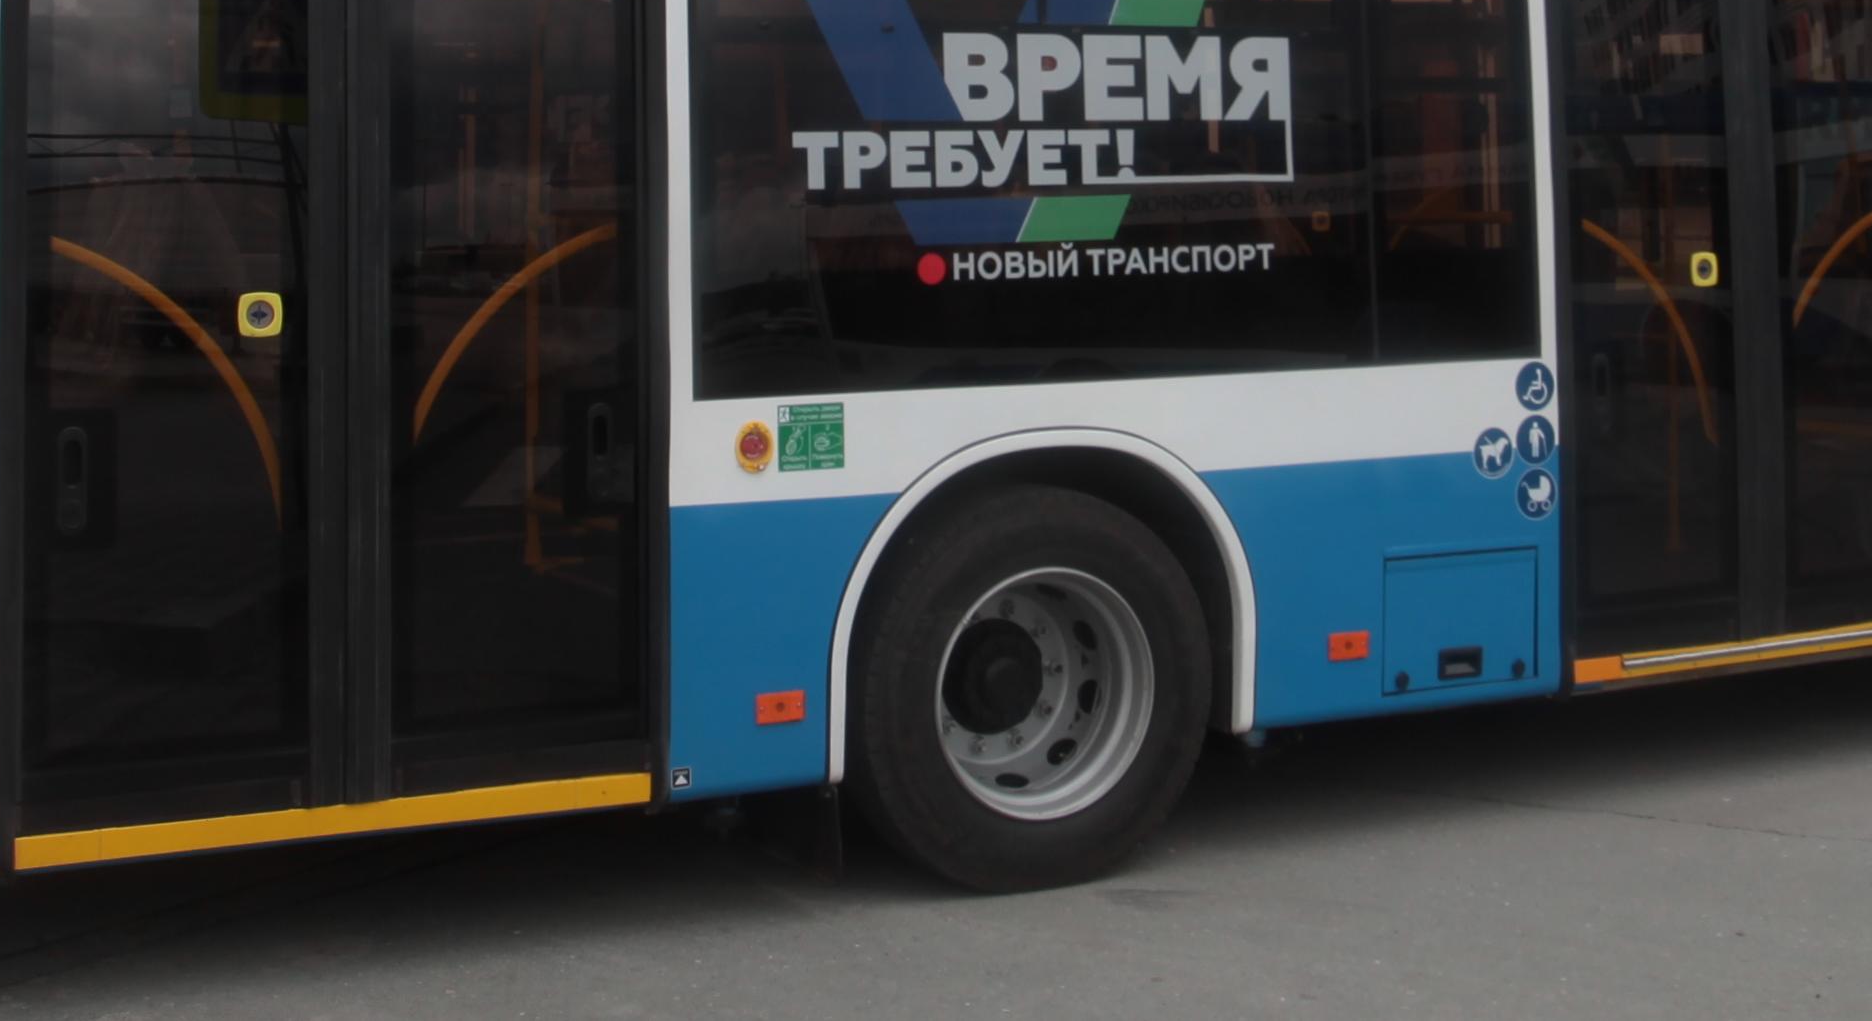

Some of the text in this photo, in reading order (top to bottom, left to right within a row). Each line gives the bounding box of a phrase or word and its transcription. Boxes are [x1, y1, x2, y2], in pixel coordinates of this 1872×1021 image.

[943, 33, 1290, 122] ВРЕМЯ
[792, 129, 1136, 190] ТРЕБУЕТ!
[952, 242, 1275, 281] НОВЫЙ ТРАНСПОРТ
